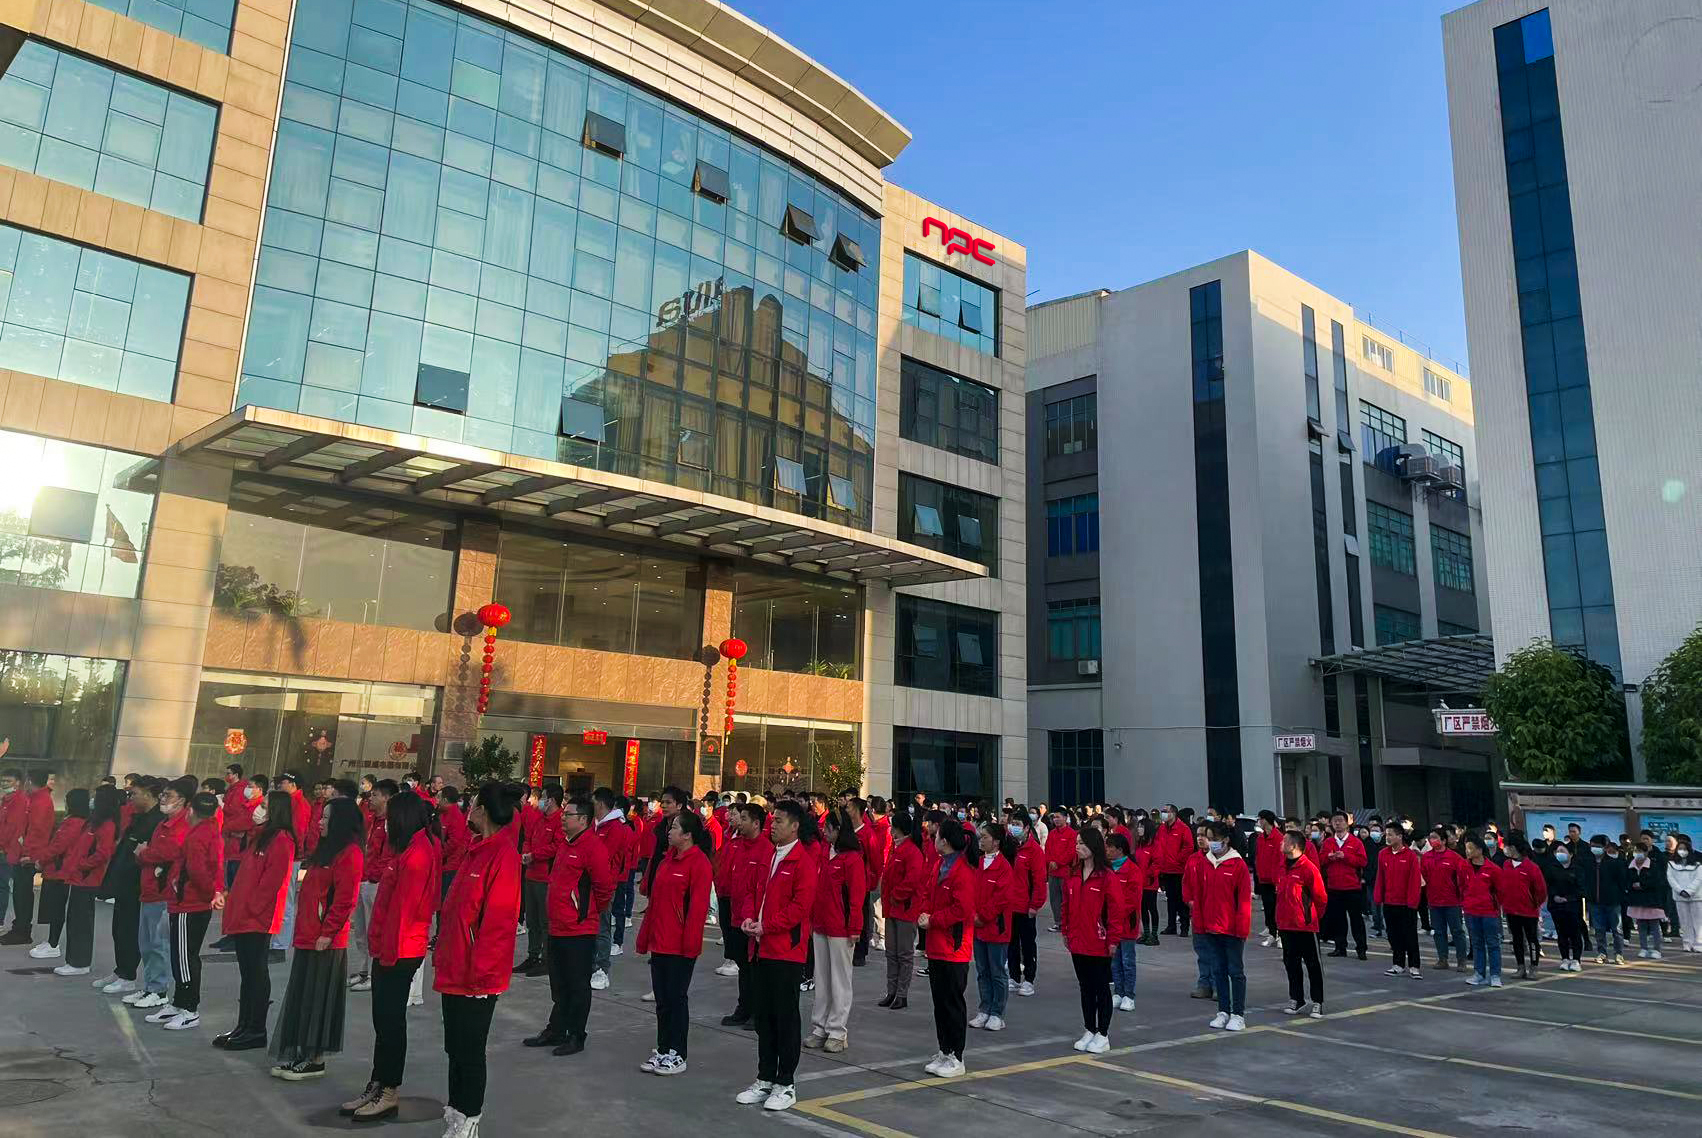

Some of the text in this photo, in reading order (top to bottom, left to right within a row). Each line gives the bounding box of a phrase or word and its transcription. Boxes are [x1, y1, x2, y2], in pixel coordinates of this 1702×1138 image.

[1444, 716, 1499, 730] 厂区严禁烟火
